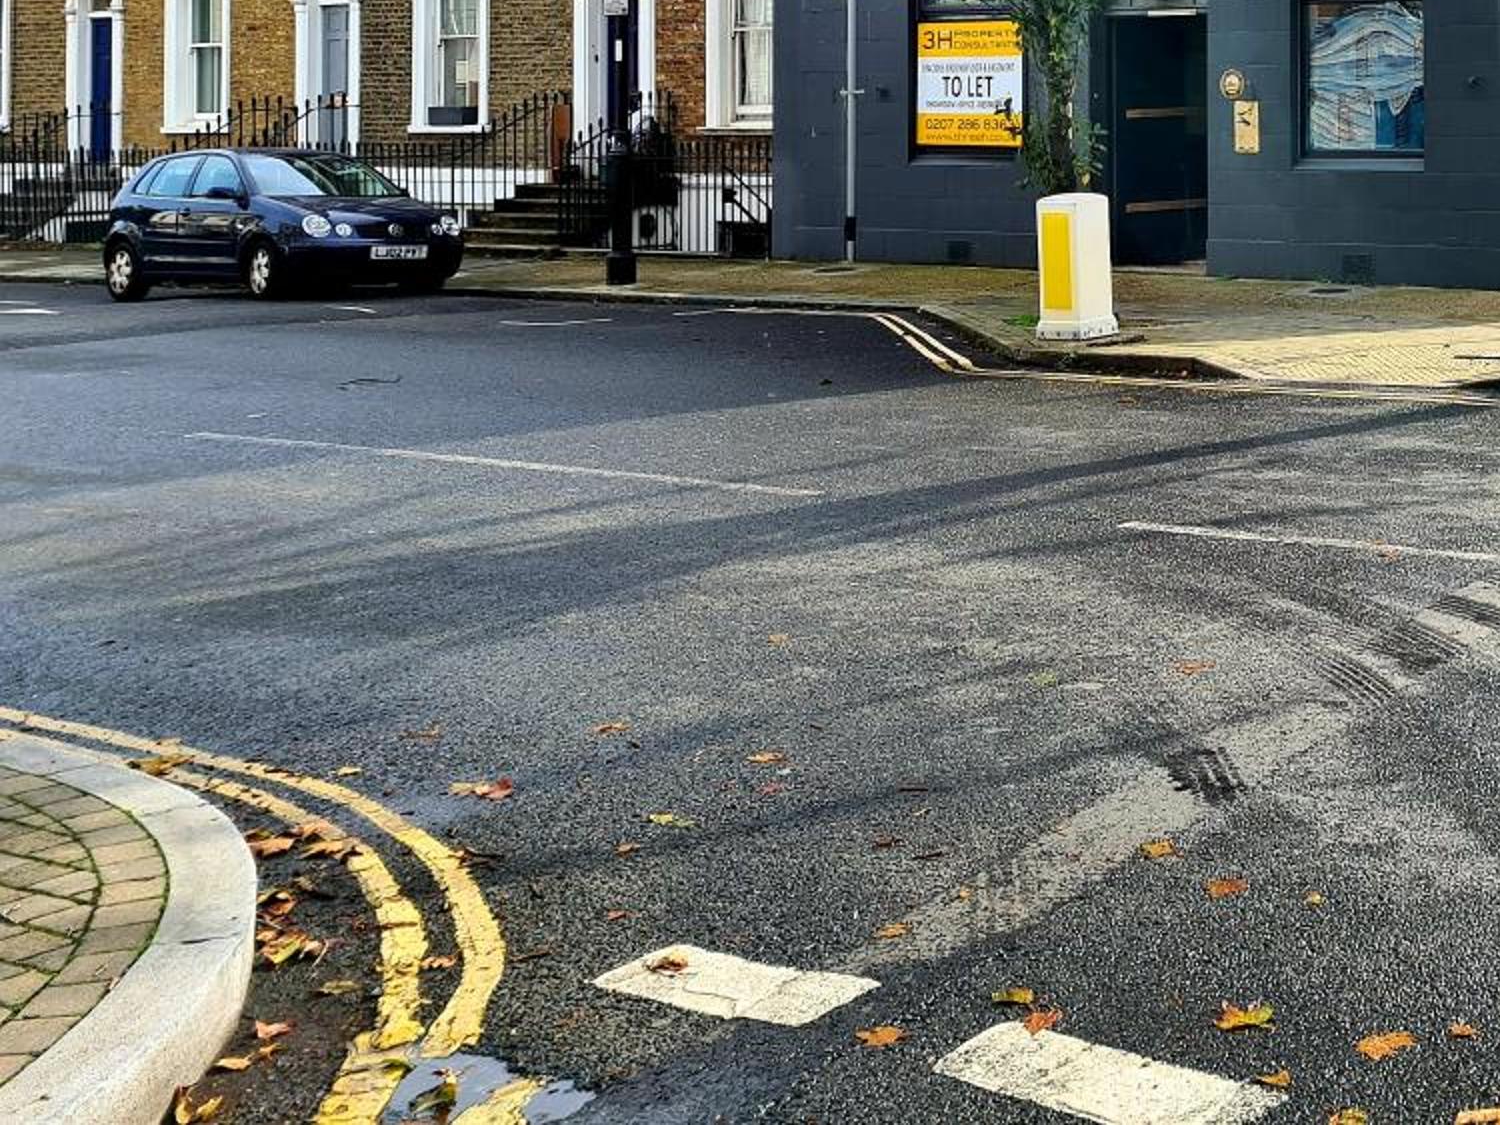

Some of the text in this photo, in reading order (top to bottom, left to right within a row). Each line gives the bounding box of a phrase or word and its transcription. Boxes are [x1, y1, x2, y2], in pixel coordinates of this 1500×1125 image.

[923, 30, 952, 49] 3H
[942, 75, 993, 97] TO LET
[926, 119, 953, 130] 0207
